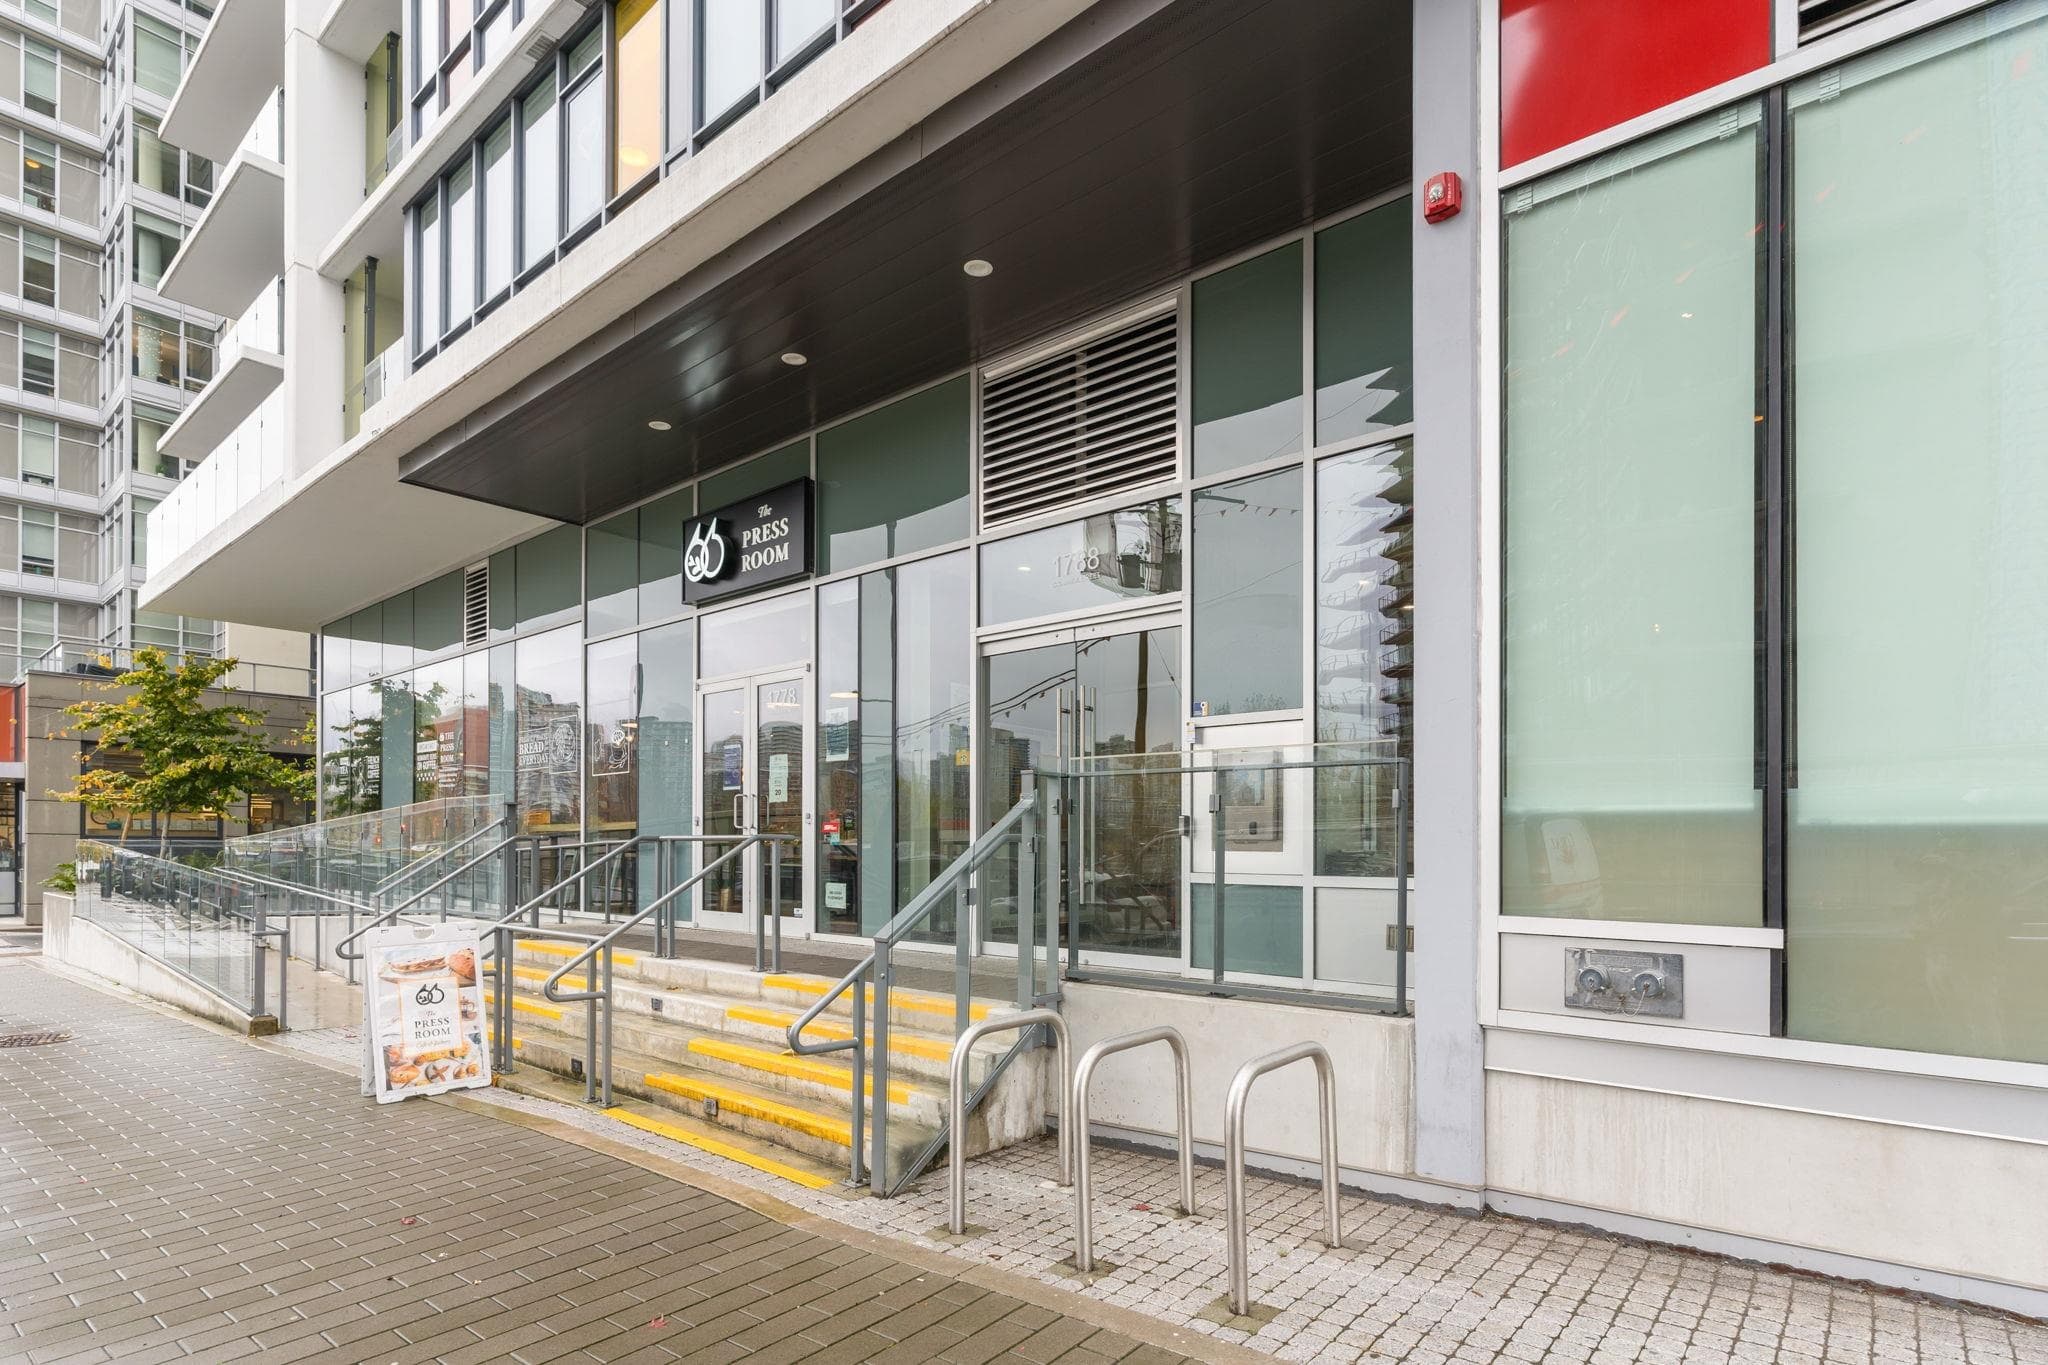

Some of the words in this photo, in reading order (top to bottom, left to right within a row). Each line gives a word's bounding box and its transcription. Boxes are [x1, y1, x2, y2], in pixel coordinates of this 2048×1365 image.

[757, 504, 773, 519] The
[742, 517, 789, 549] PRESS
[741, 542, 790, 573] ROOM
[519, 741, 544, 755] BREAD
[414, 1017, 450, 1028] PRESS
[414, 1027, 452, 1039] ROOM
